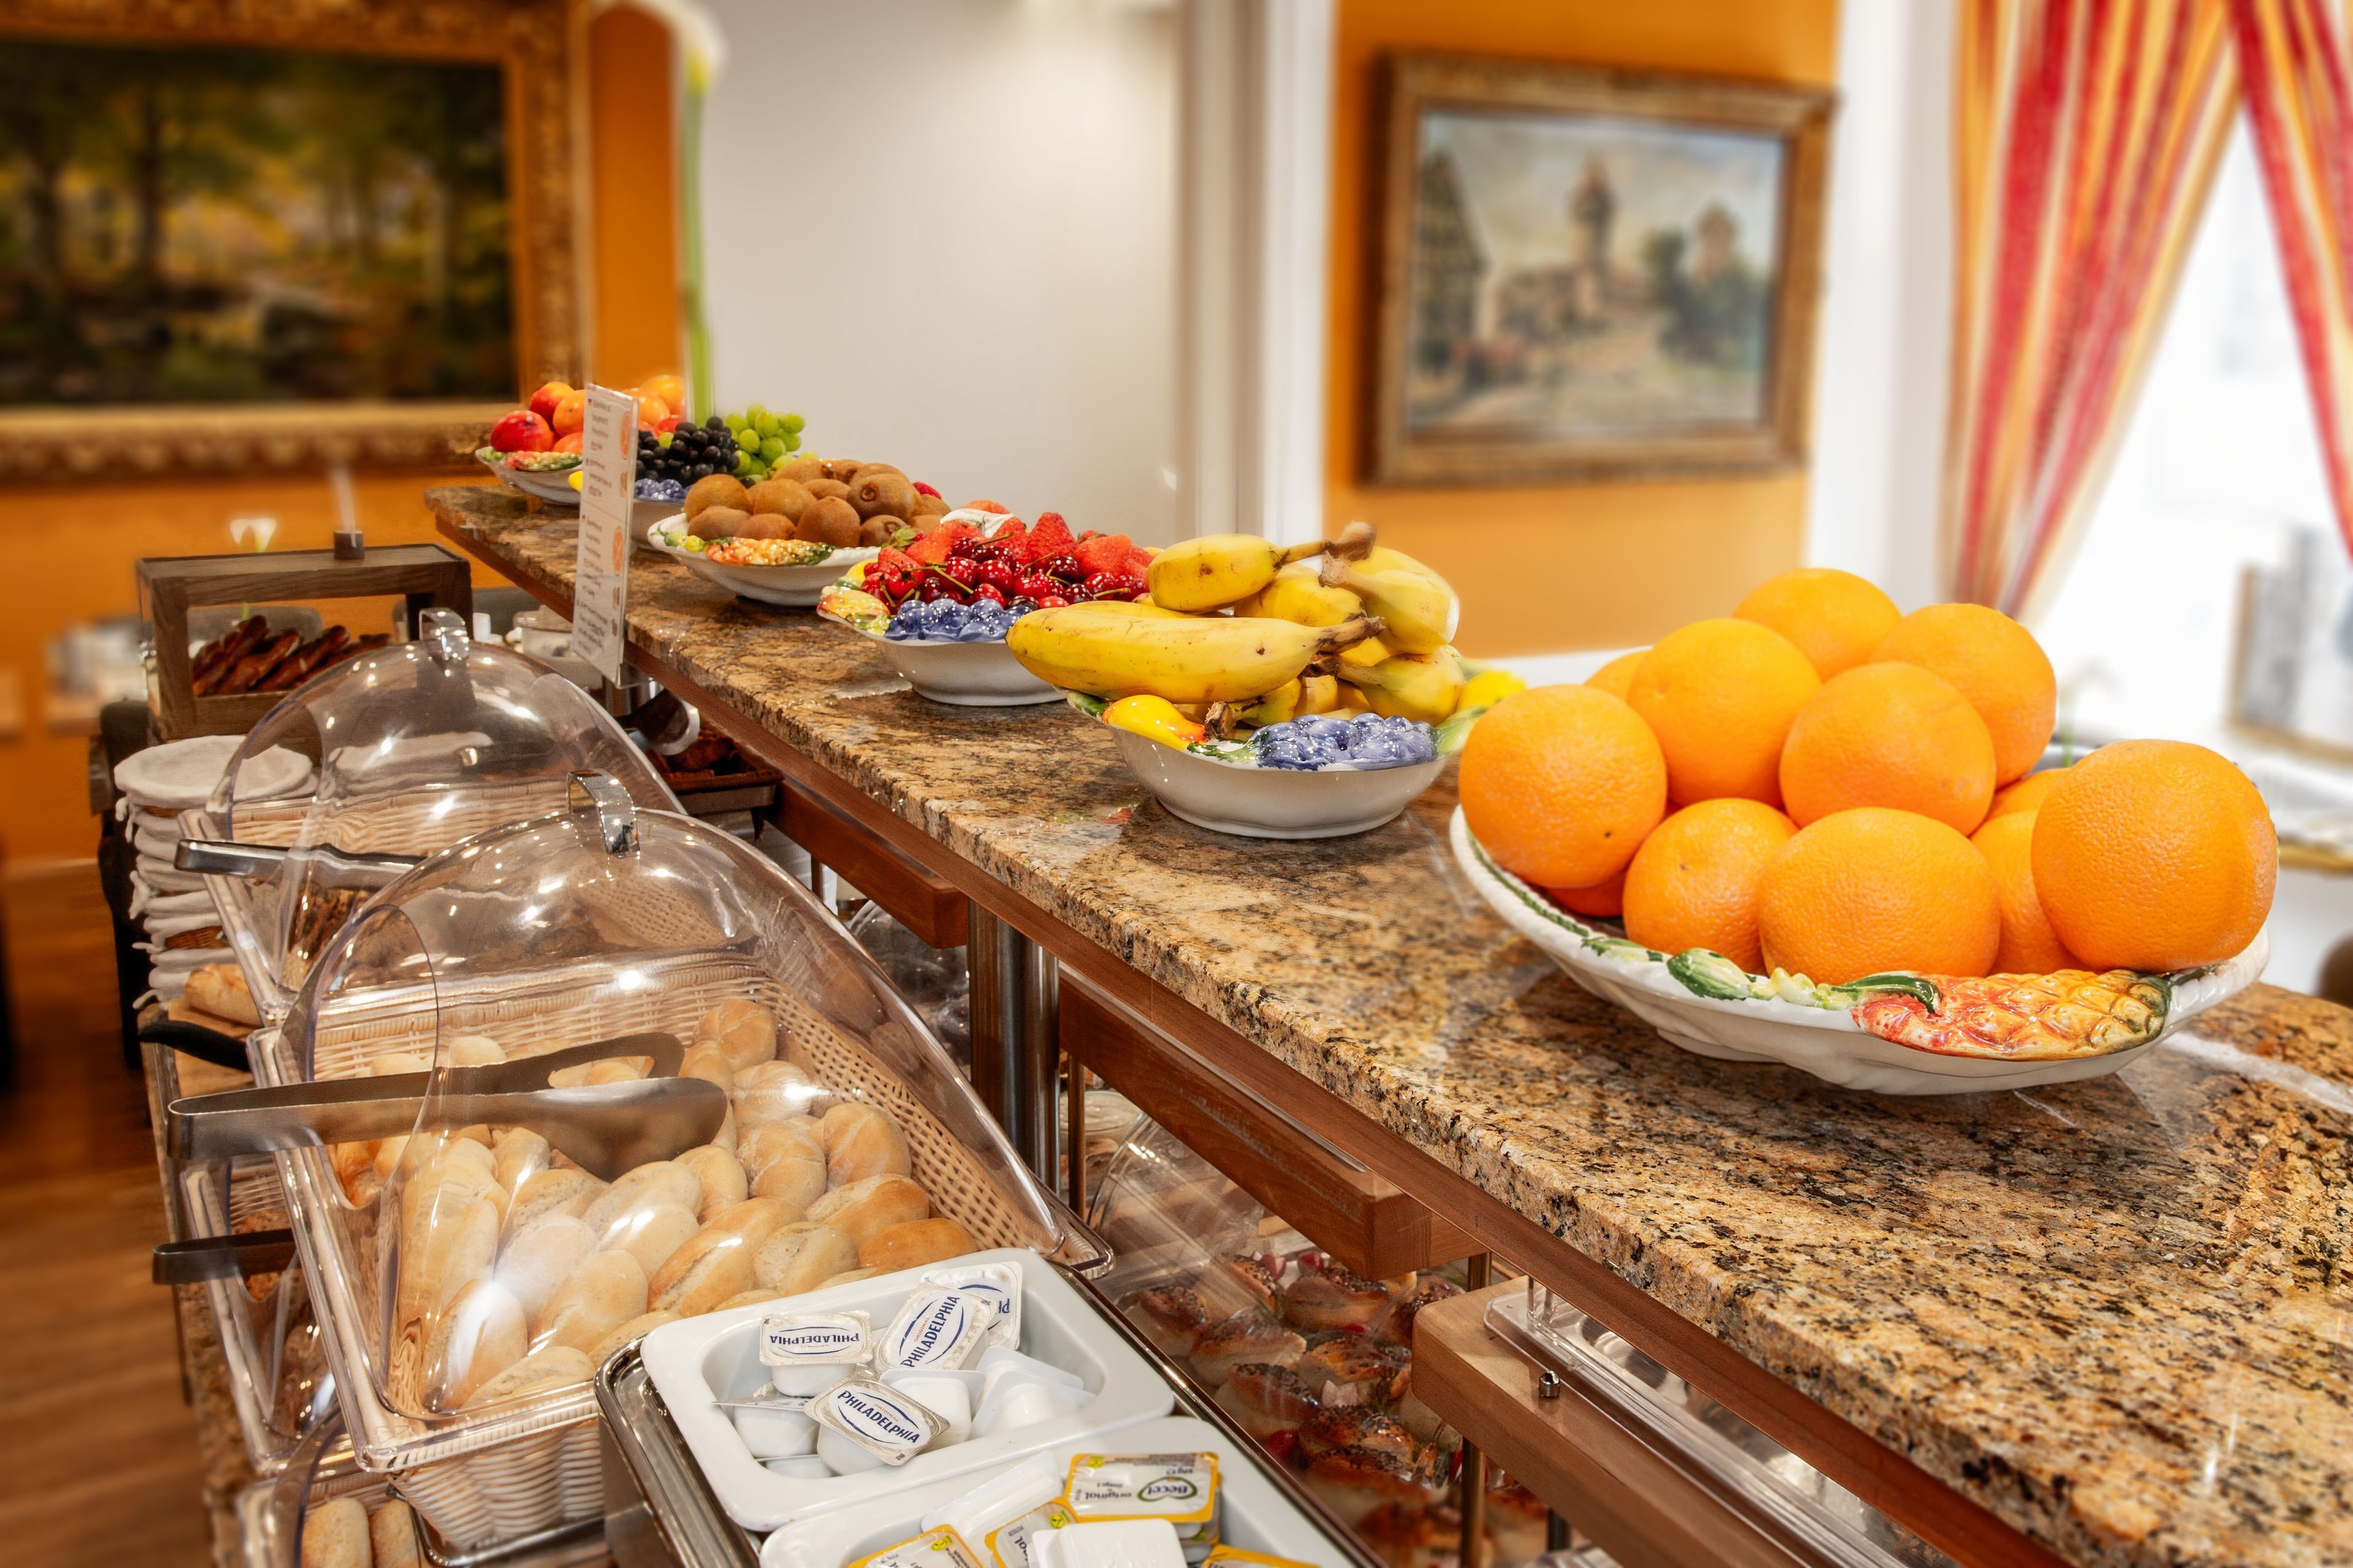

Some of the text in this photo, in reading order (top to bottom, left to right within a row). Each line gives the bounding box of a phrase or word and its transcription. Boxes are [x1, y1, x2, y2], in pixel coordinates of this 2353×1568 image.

[770, 1333, 859, 1345] PHILADELPHIA
[901, 1296, 960, 1367] PHILADELPHIA
[914, 1317, 931, 1342] ORIGINAL
[838, 1390, 920, 1443] PHILADELPHIA
[874, 1403, 901, 1422] ORIGINAL
[1085, 1491, 1132, 1501] original
[1147, 1485, 1189, 1495] Becel
